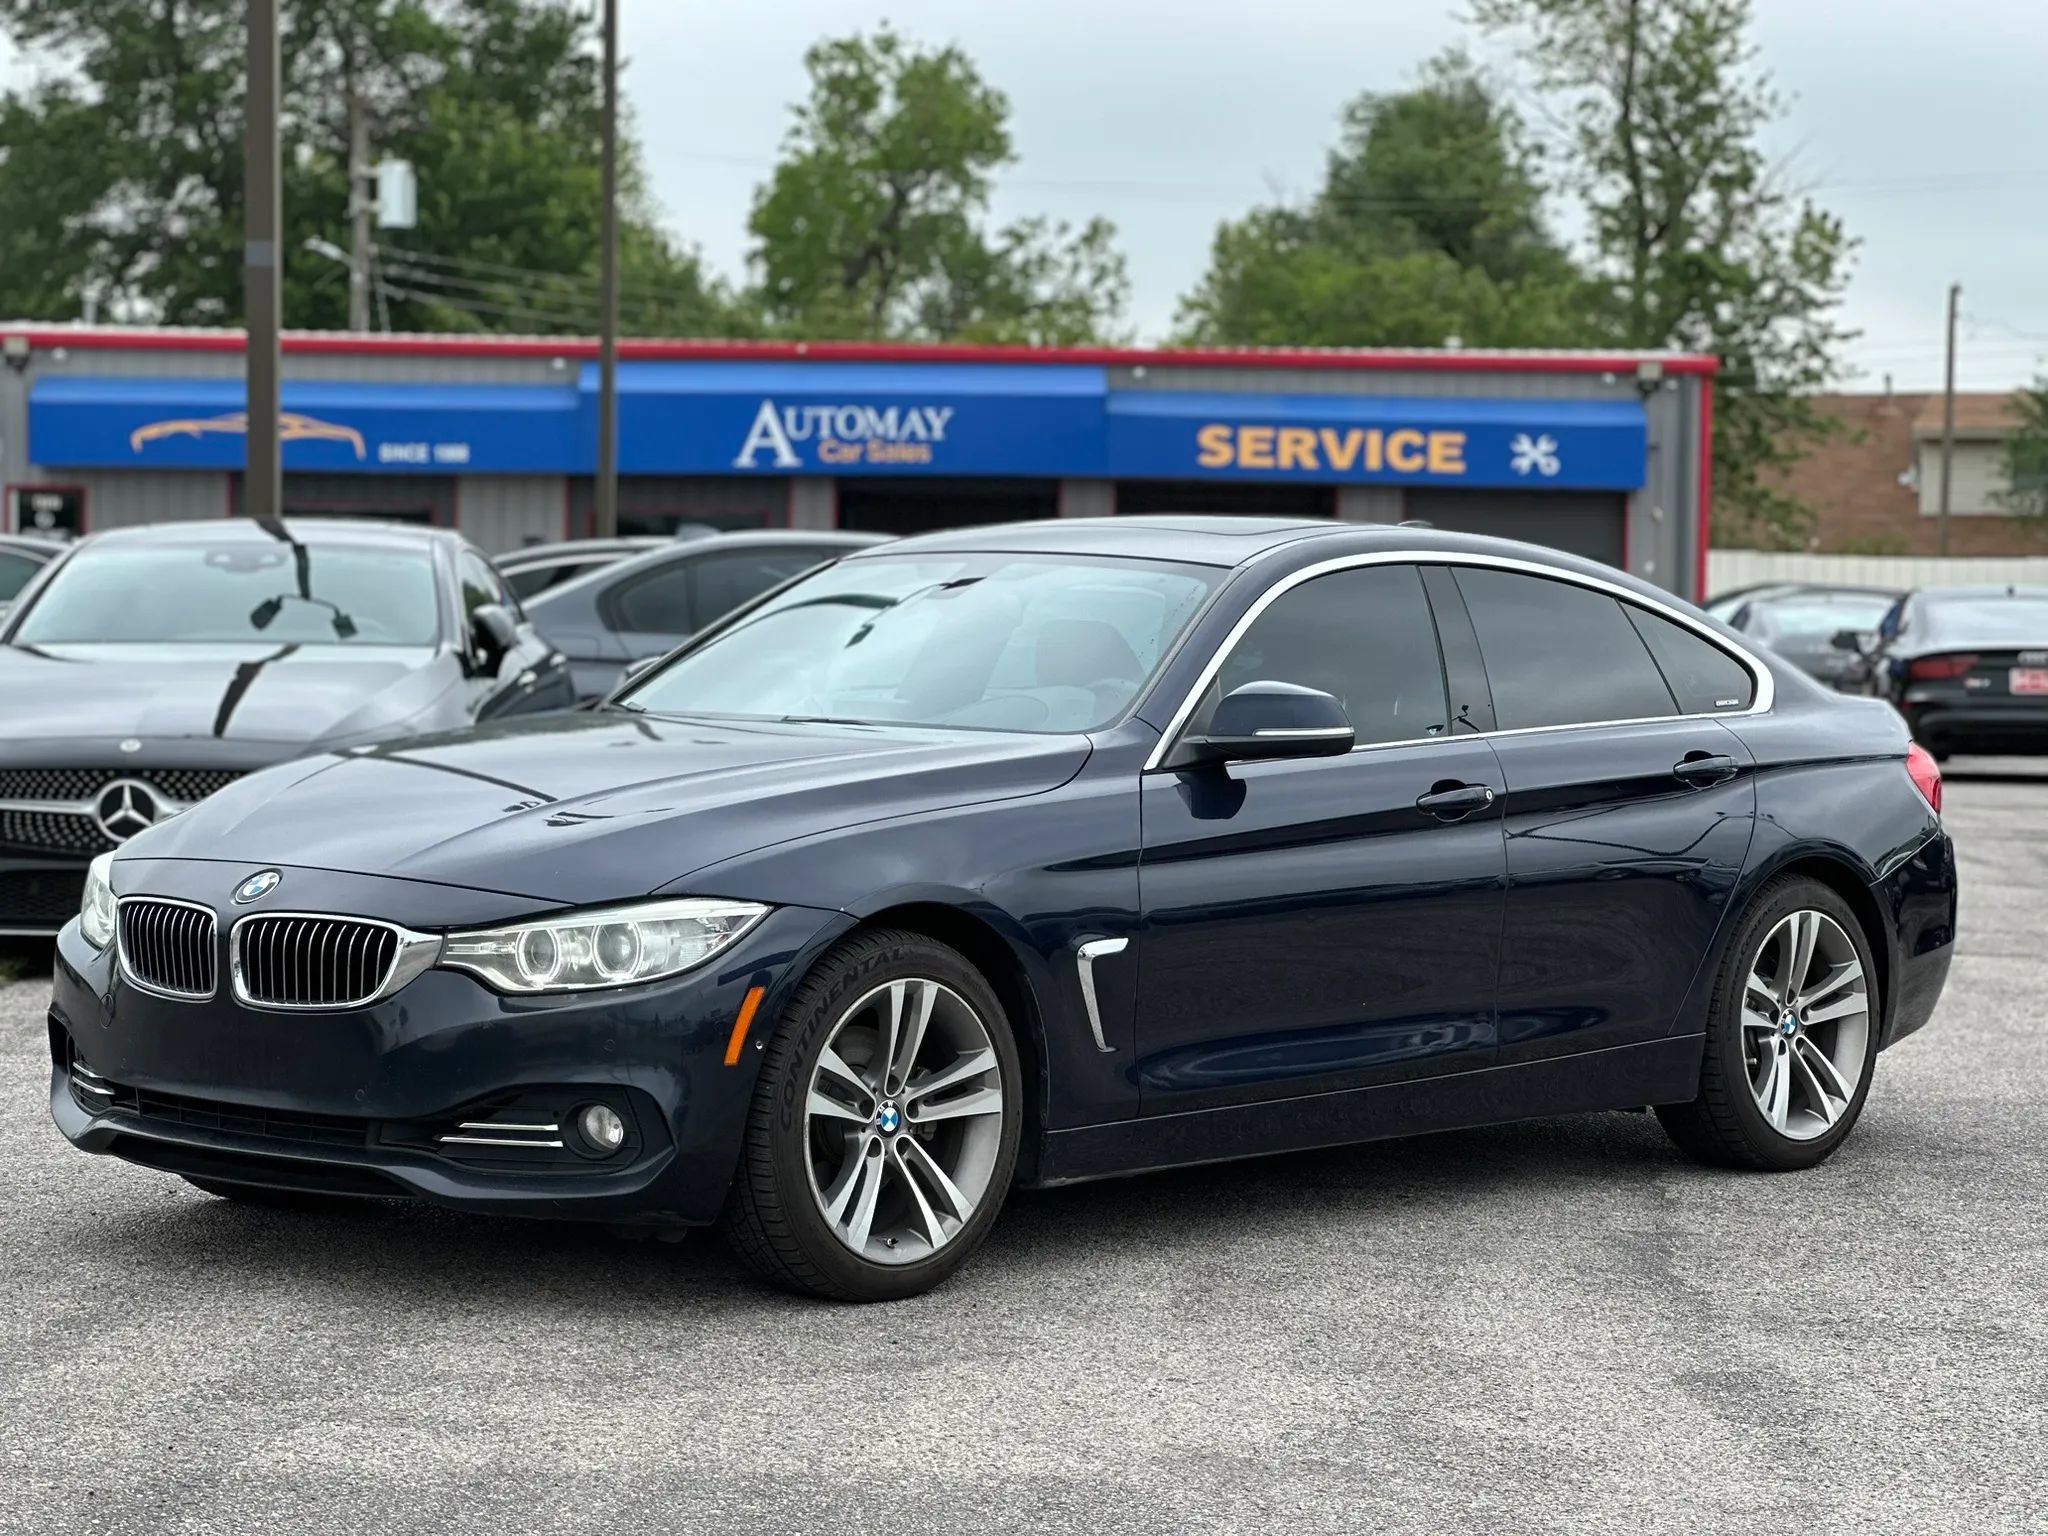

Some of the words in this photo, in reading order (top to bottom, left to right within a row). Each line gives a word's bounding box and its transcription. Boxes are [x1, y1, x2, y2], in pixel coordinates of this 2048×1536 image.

[732, 399, 954, 468] AUTOMAY
[818, 438, 863, 464] Car
[867, 438, 932, 464] Sales
[1197, 424, 1467, 474] SERVICE
[781, 947, 907, 1130] CONTINENTAL
